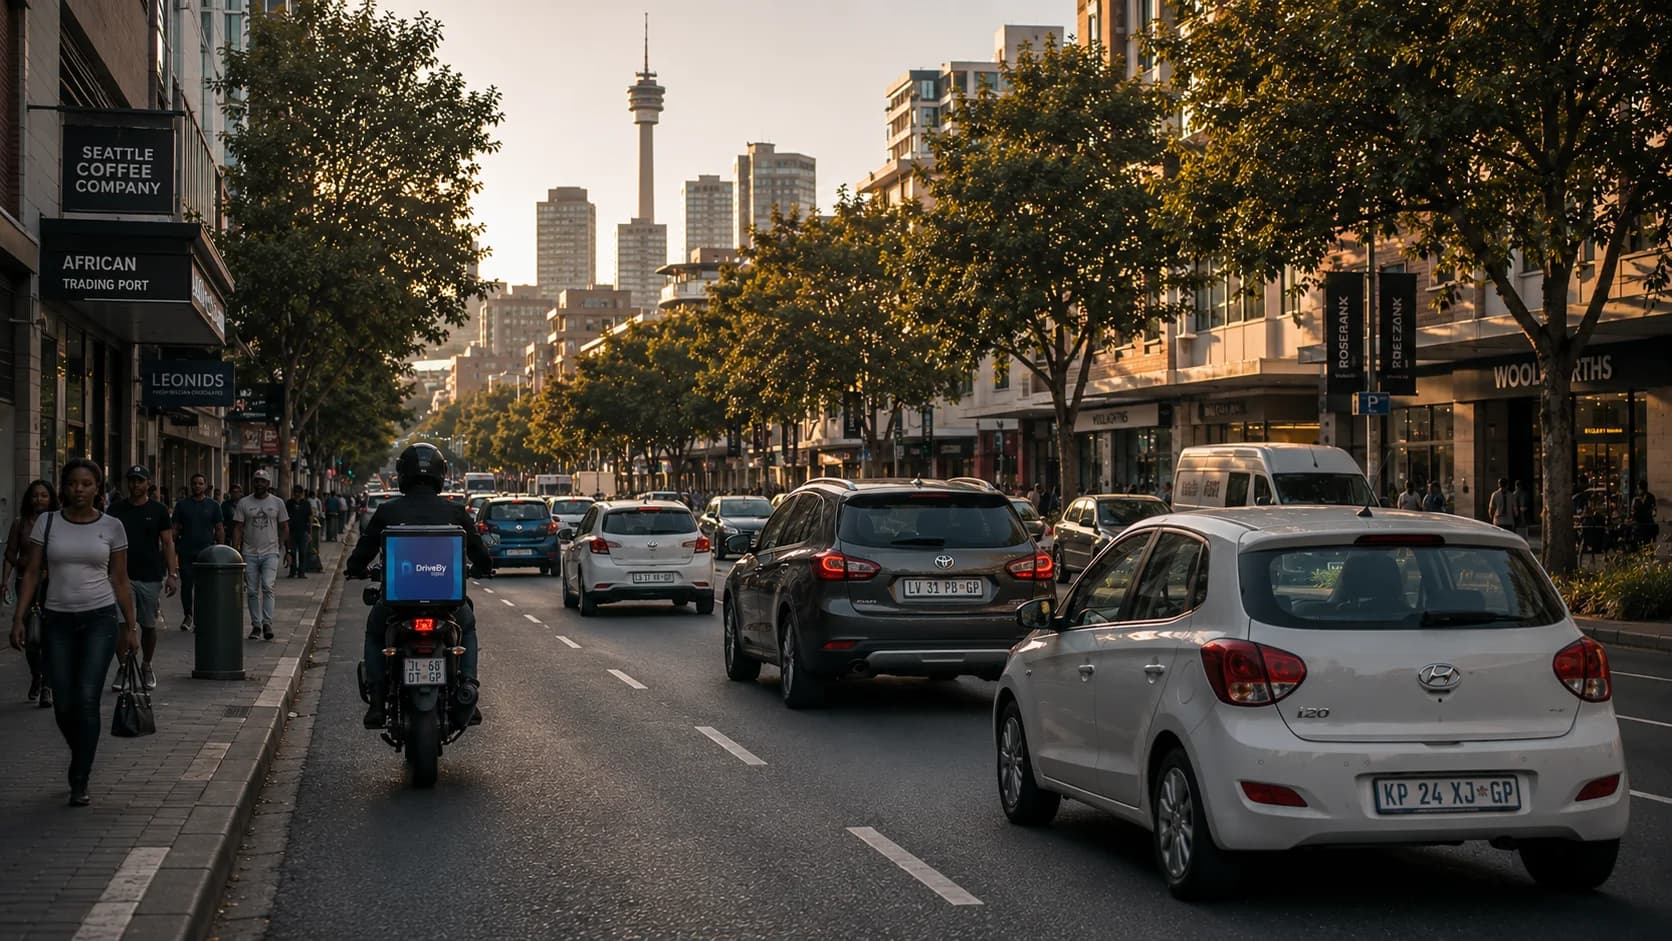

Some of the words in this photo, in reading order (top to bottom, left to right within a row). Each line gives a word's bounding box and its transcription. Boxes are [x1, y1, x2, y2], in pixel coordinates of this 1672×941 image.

[82, 146, 154, 161] SEATTLE
[76, 162, 152, 178] COFFEE
[75, 179, 161, 195] COMPANY
[62, 255, 137, 272] AFRICAN
[62, 278, 115, 290] TRADING
[118, 279, 149, 291] PORT
[1494, 355, 1613, 389] WOOLRTHS
[152, 373, 224, 388] LEONIDS
[1367, 395, 1378, 408] P
[416, 564, 446, 573] DriveBy
[908, 580, 922, 594] LV
[927, 581, 939, 594] 31
[945, 580, 958, 593] PB
[966, 580, 979, 593] GP
[428, 660, 440, 671] 68
[408, 672, 421, 683] DT
[429, 672, 441, 682] GP
[1297, 706, 1330, 719] i20
[1384, 783, 1408, 806] KP
[1418, 782, 1443, 805] 24
[1450, 782, 1475, 804] XJ
[1490, 781, 1513, 804] GP
